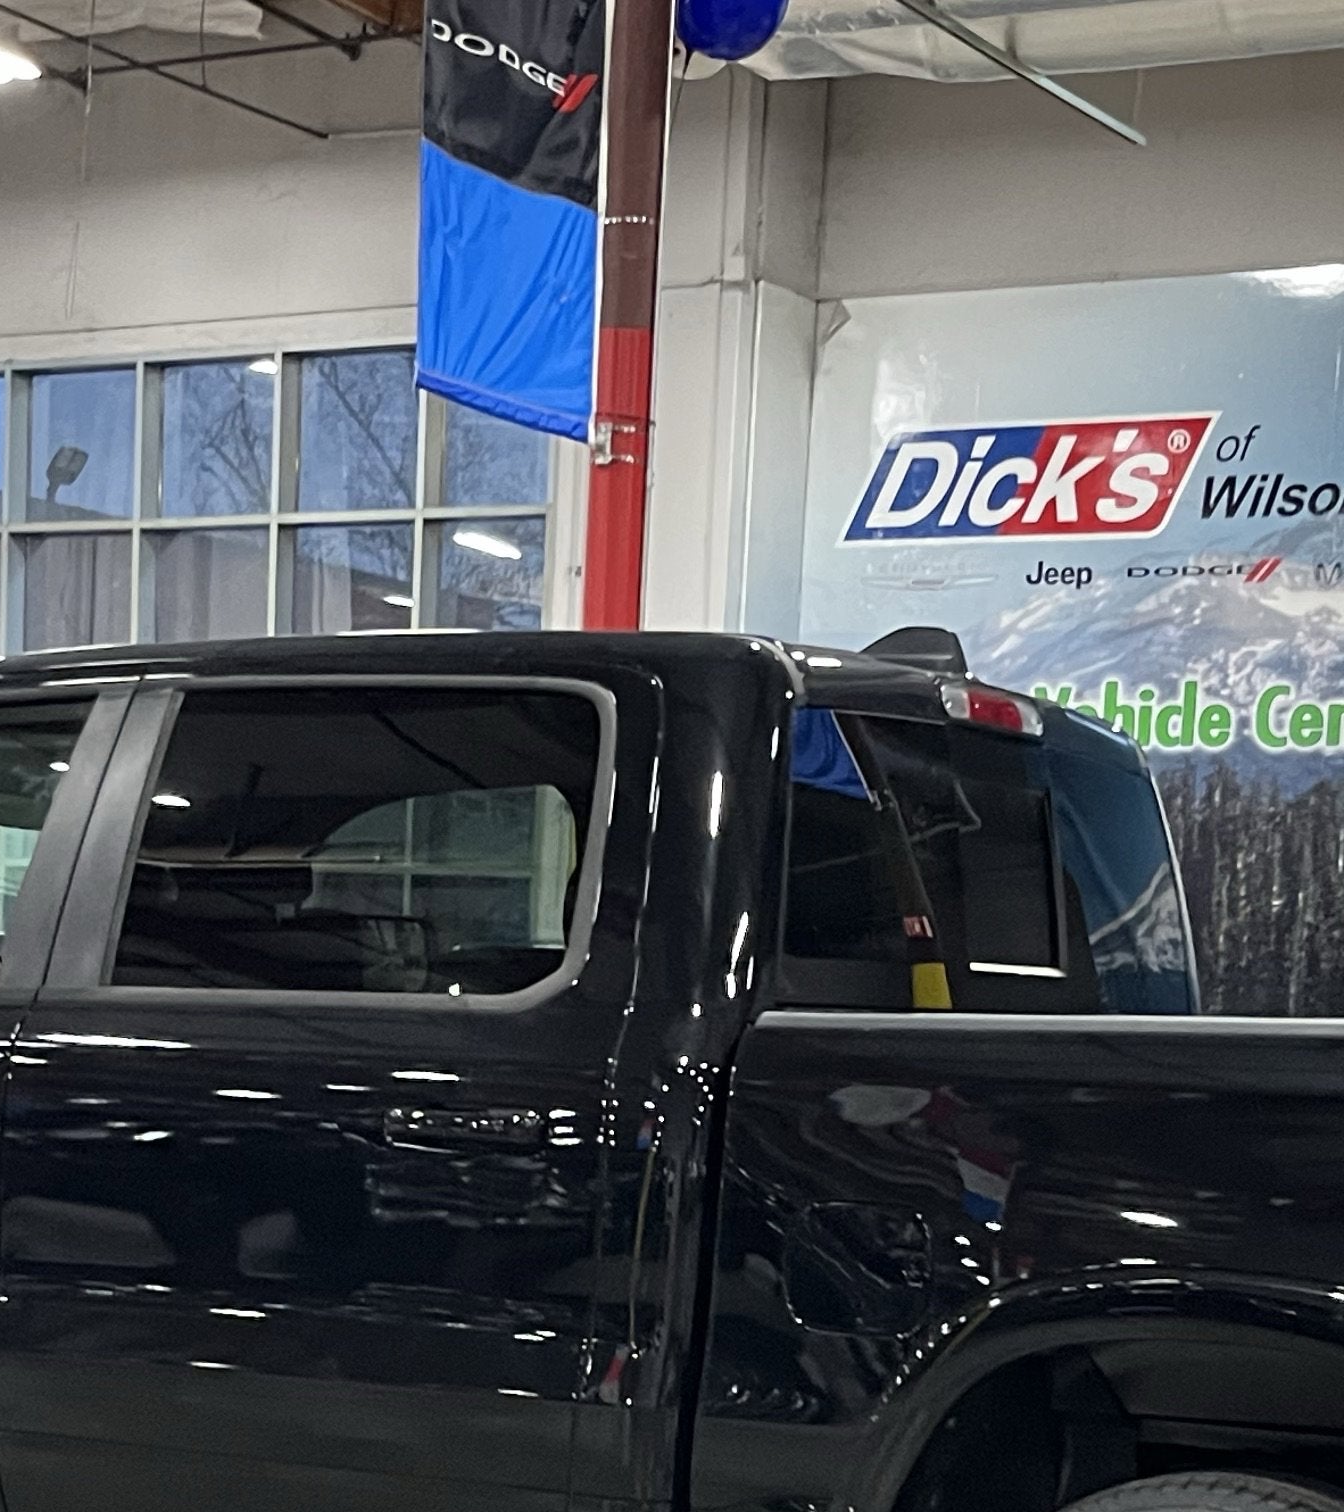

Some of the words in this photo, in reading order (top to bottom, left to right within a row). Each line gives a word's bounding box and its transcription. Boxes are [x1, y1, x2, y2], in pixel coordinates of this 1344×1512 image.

[431, 19, 568, 97] DODGE
[1217, 425, 1260, 463] of
[865, 428, 1170, 529] Dick's
[1026, 561, 1093, 589] Jeep
[1035, 680, 1232, 748] hicle
